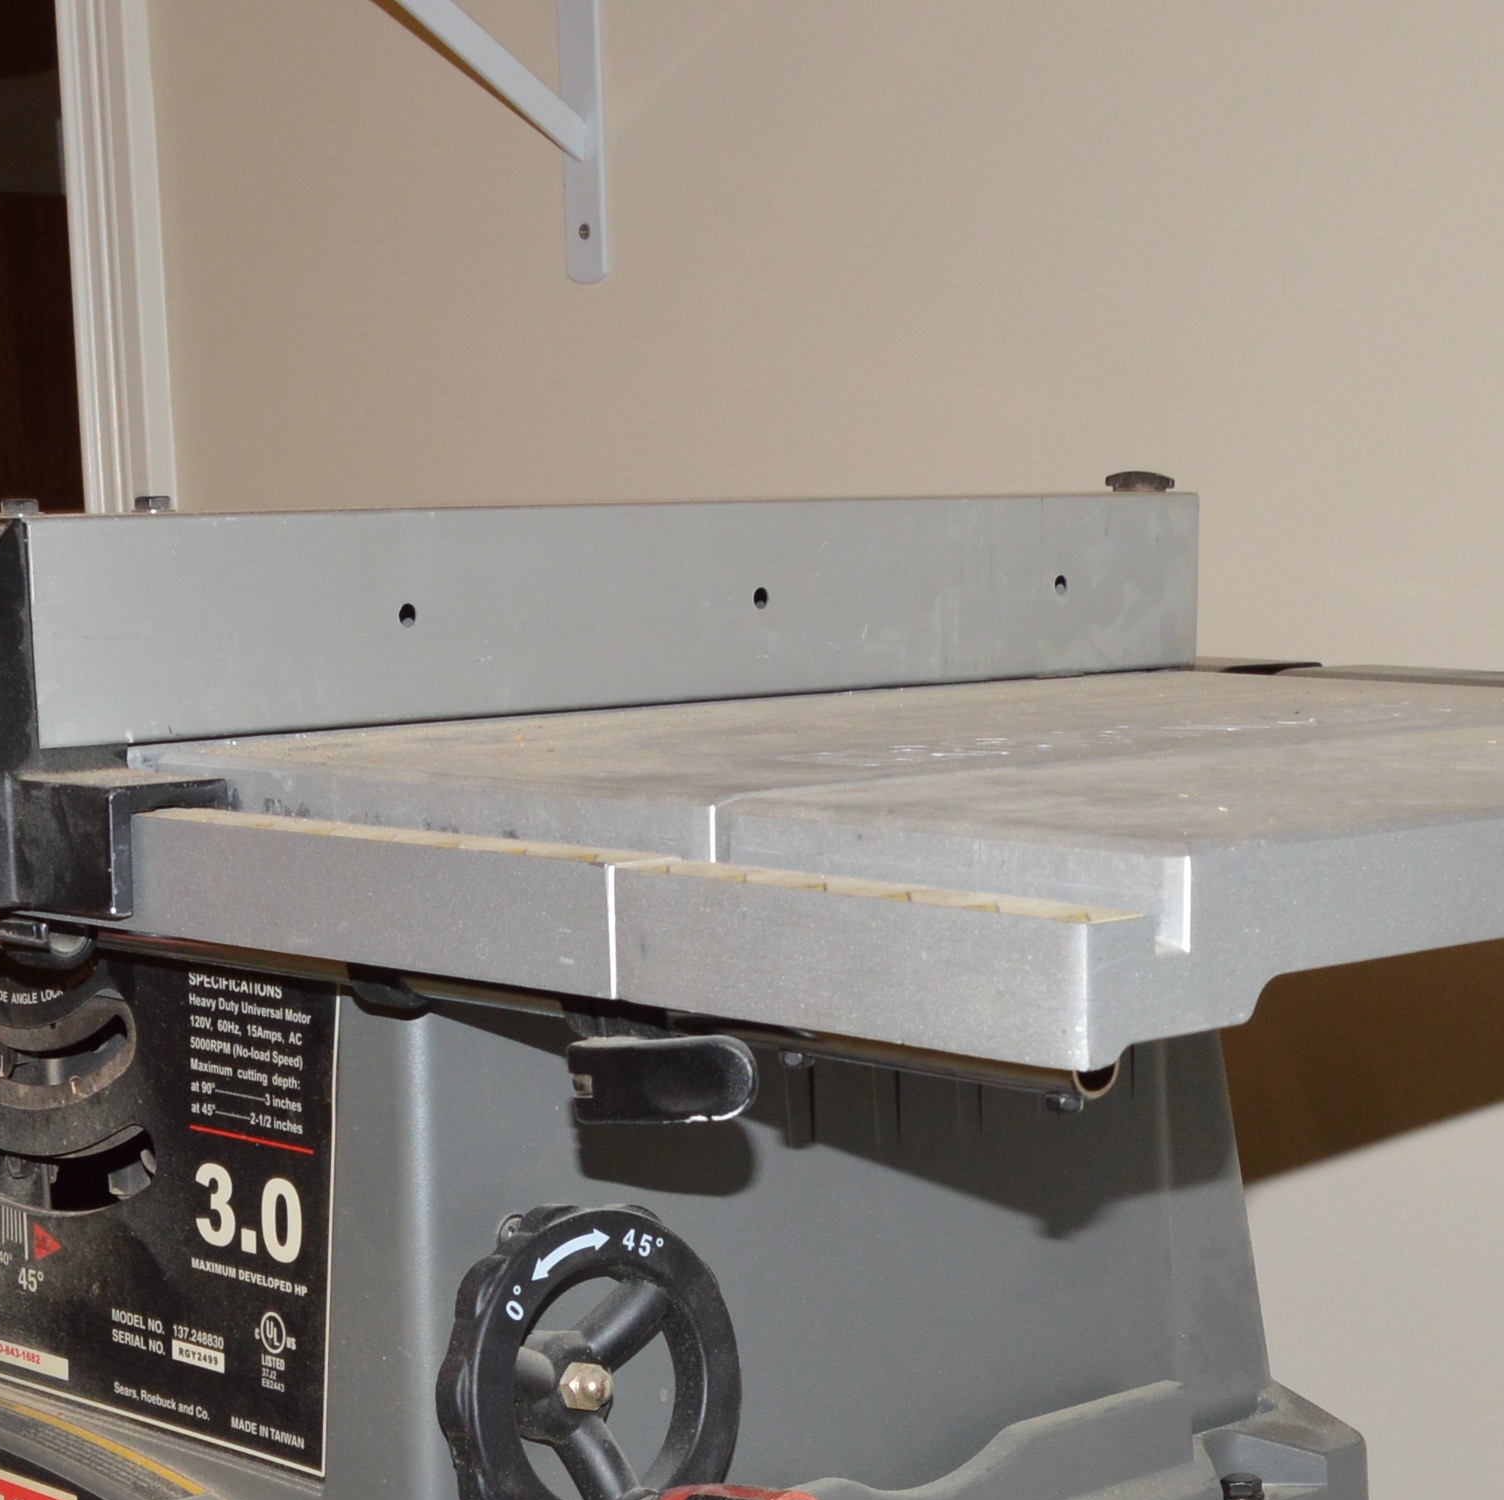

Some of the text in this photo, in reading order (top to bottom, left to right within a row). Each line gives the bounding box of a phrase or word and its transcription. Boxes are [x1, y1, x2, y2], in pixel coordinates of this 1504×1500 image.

[11, 992, 39, 1005] ANGLE
[188, 971, 283, 999] SPECIFICATIONS
[188, 993, 312, 1025] Heavy Duty Universal Motor
[189, 1014, 303, 1046] 120V, 60Hz, 15Amps, AC
[190, 1036, 304, 1071] 5000RPM (No-load Speed)
[190, 1057, 301, 1090] Maximum cutting depth:
[191, 1081, 200, 1093] at
[272, 1095, 302, 1113] inches
[191, 1102, 200, 1114] at
[273, 1116, 303, 1135] inches
[194, 1162, 303, 1264] 3.0
[622, 1228, 665, 1258] 45°
[18, 1267, 45, 1293] 45°
[191, 1257, 308, 1297] MAXIMUM DEVELOPED HP
[111, 1308, 147, 1331] MODEL
[147, 1317, 166, 1335] NO.
[111, 1328, 219, 1367] SERIAL NO. RGY2499
[261, 1353, 286, 1372] LISTED
[113, 1381, 211, 1421] Sears, Roebuck and Co.
[230, 1415, 305, 1450] MADE IN TAIWAN
